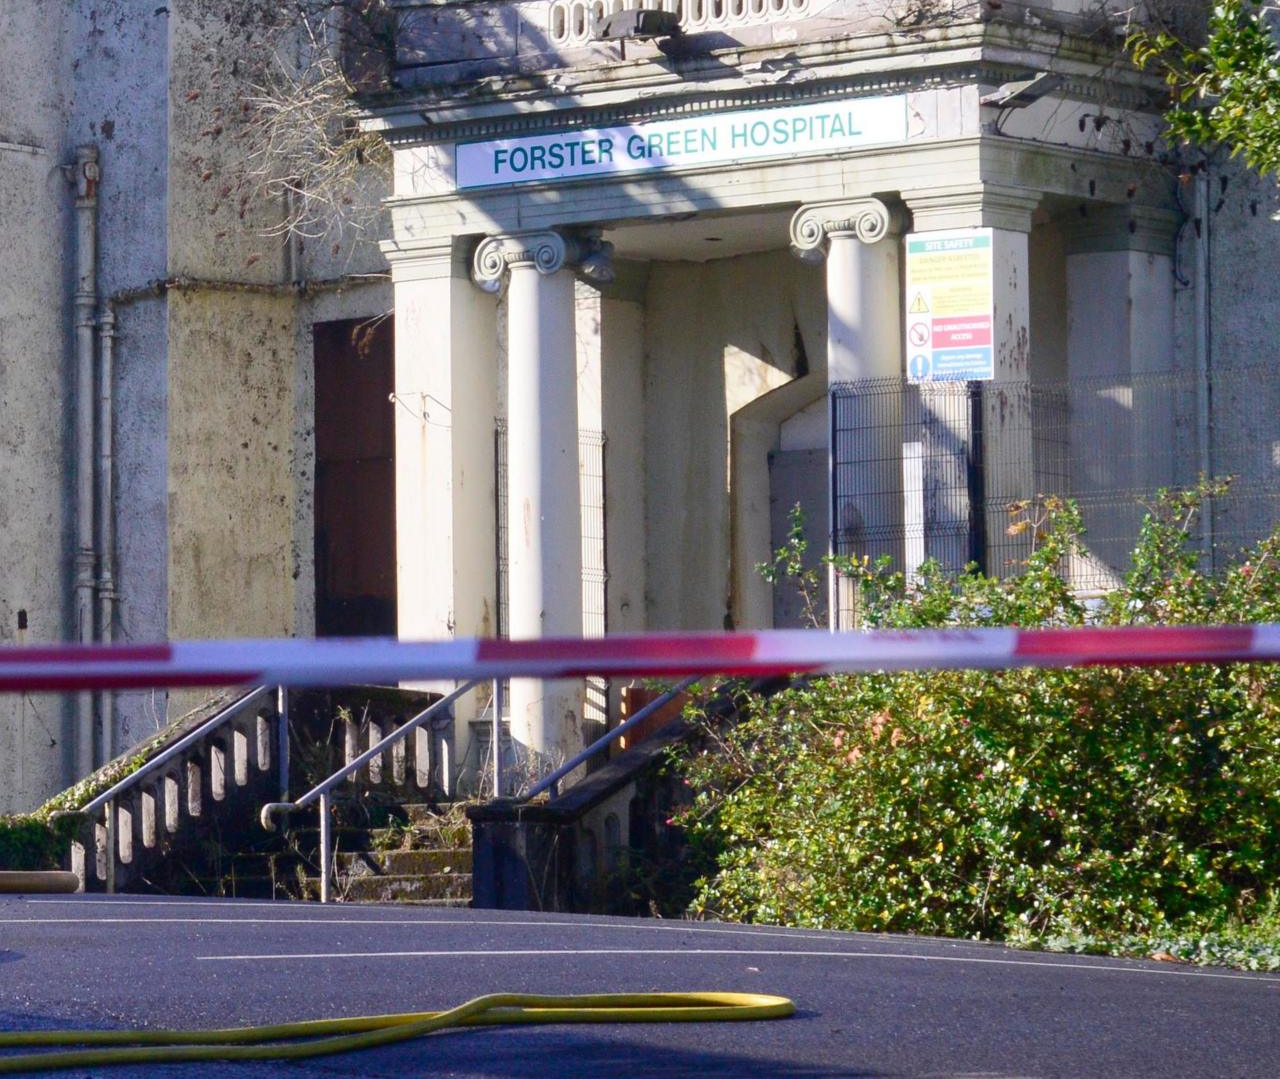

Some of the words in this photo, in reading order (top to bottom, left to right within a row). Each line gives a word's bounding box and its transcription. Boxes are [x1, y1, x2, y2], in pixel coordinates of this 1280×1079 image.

[493, 137, 614, 175] FORSTER
[626, 126, 718, 162] GREEN
[730, 111, 863, 150] HOSPITAL
[925, 240, 942, 251] SITE
[944, 238, 975, 249] SAFETY
